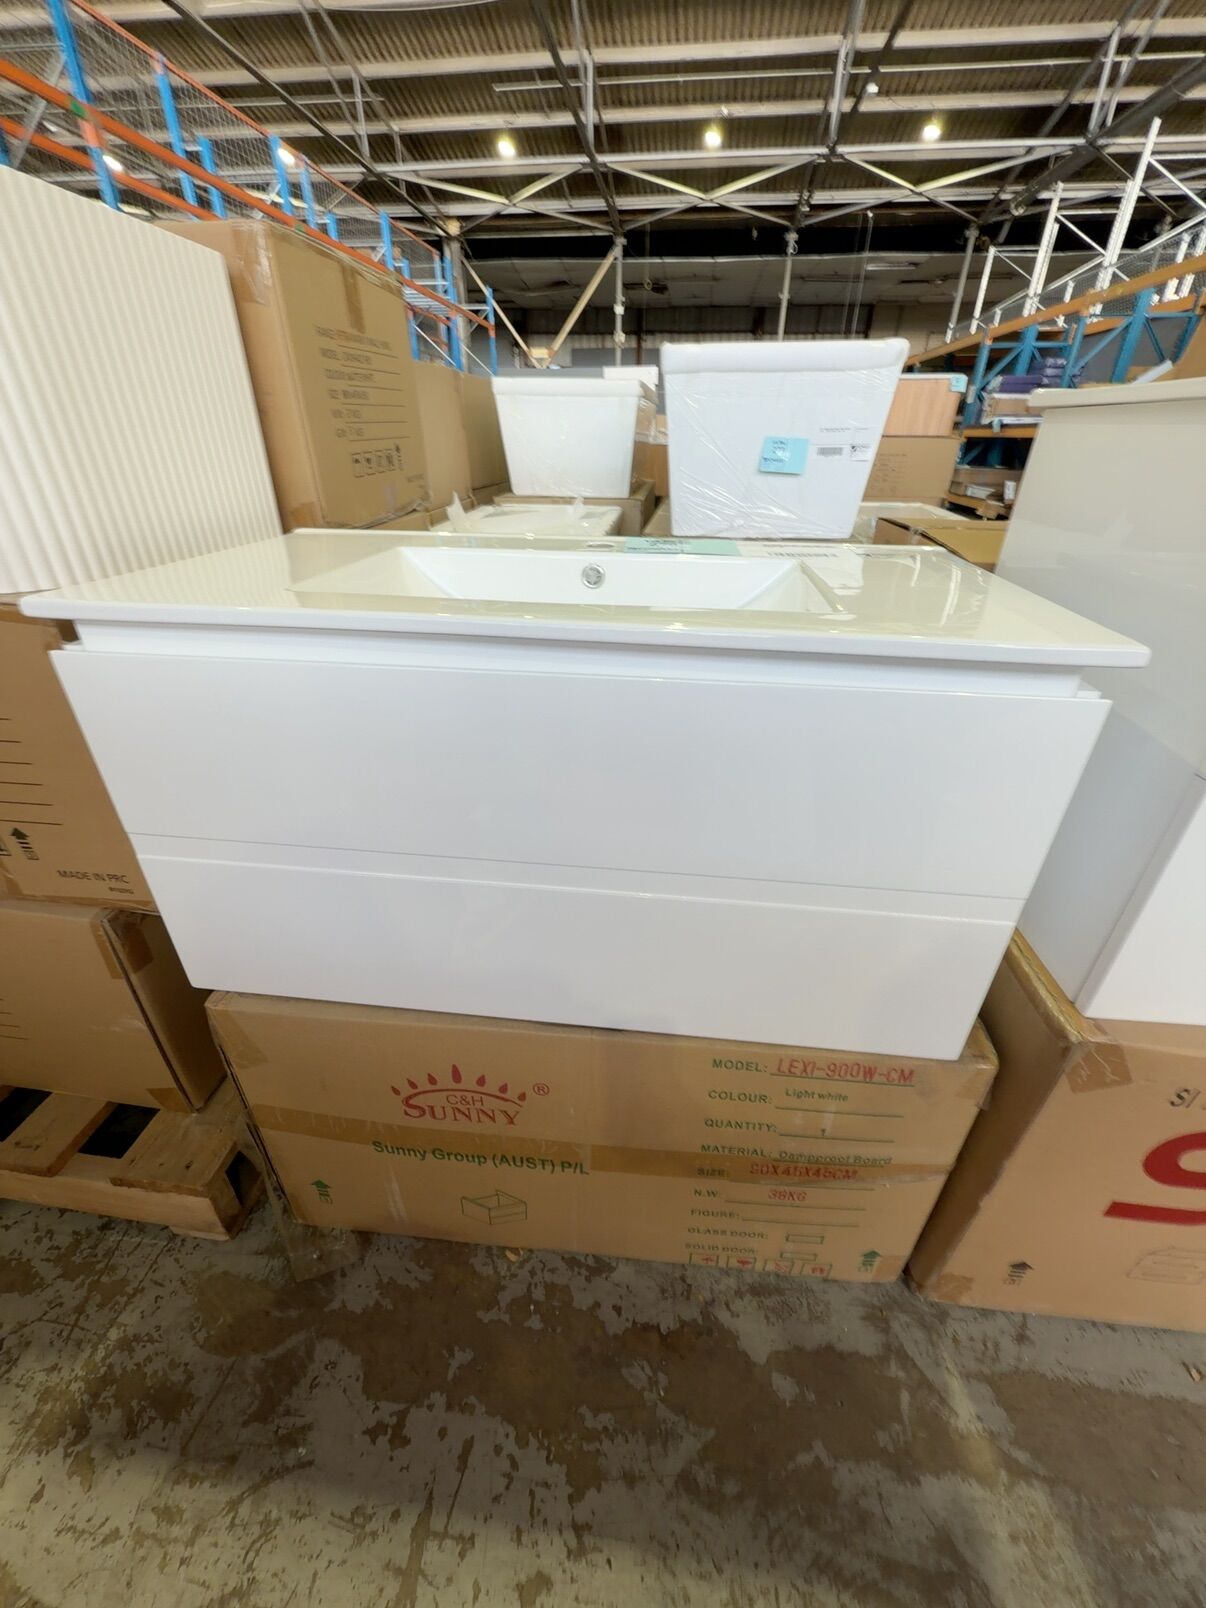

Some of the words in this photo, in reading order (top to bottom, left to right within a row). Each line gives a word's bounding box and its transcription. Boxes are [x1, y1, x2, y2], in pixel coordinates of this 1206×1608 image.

[711, 1058, 768, 1073] MODEL:
[776, 1058, 915, 1084] LEXI-900W-CM
[446, 1093, 485, 1107] C&H
[707, 1089, 772, 1104] COLOUR:
[784, 1087, 815, 1101] Light
[817, 1092, 849, 1103] white
[402, 1091, 521, 1127] SUNNY
[704, 1118, 777, 1133] QUANTITY:
[371, 1140, 427, 1161] Sunny
[431, 1148, 488, 1167] Group
[491, 1153, 556, 1175] (AUST)
[560, 1161, 590, 1175] P/L
[700, 1144, 774, 1158] MATERIAL:
[854, 1156, 894, 1167] Board
[689, 1208, 741, 1220] FIGURE:
